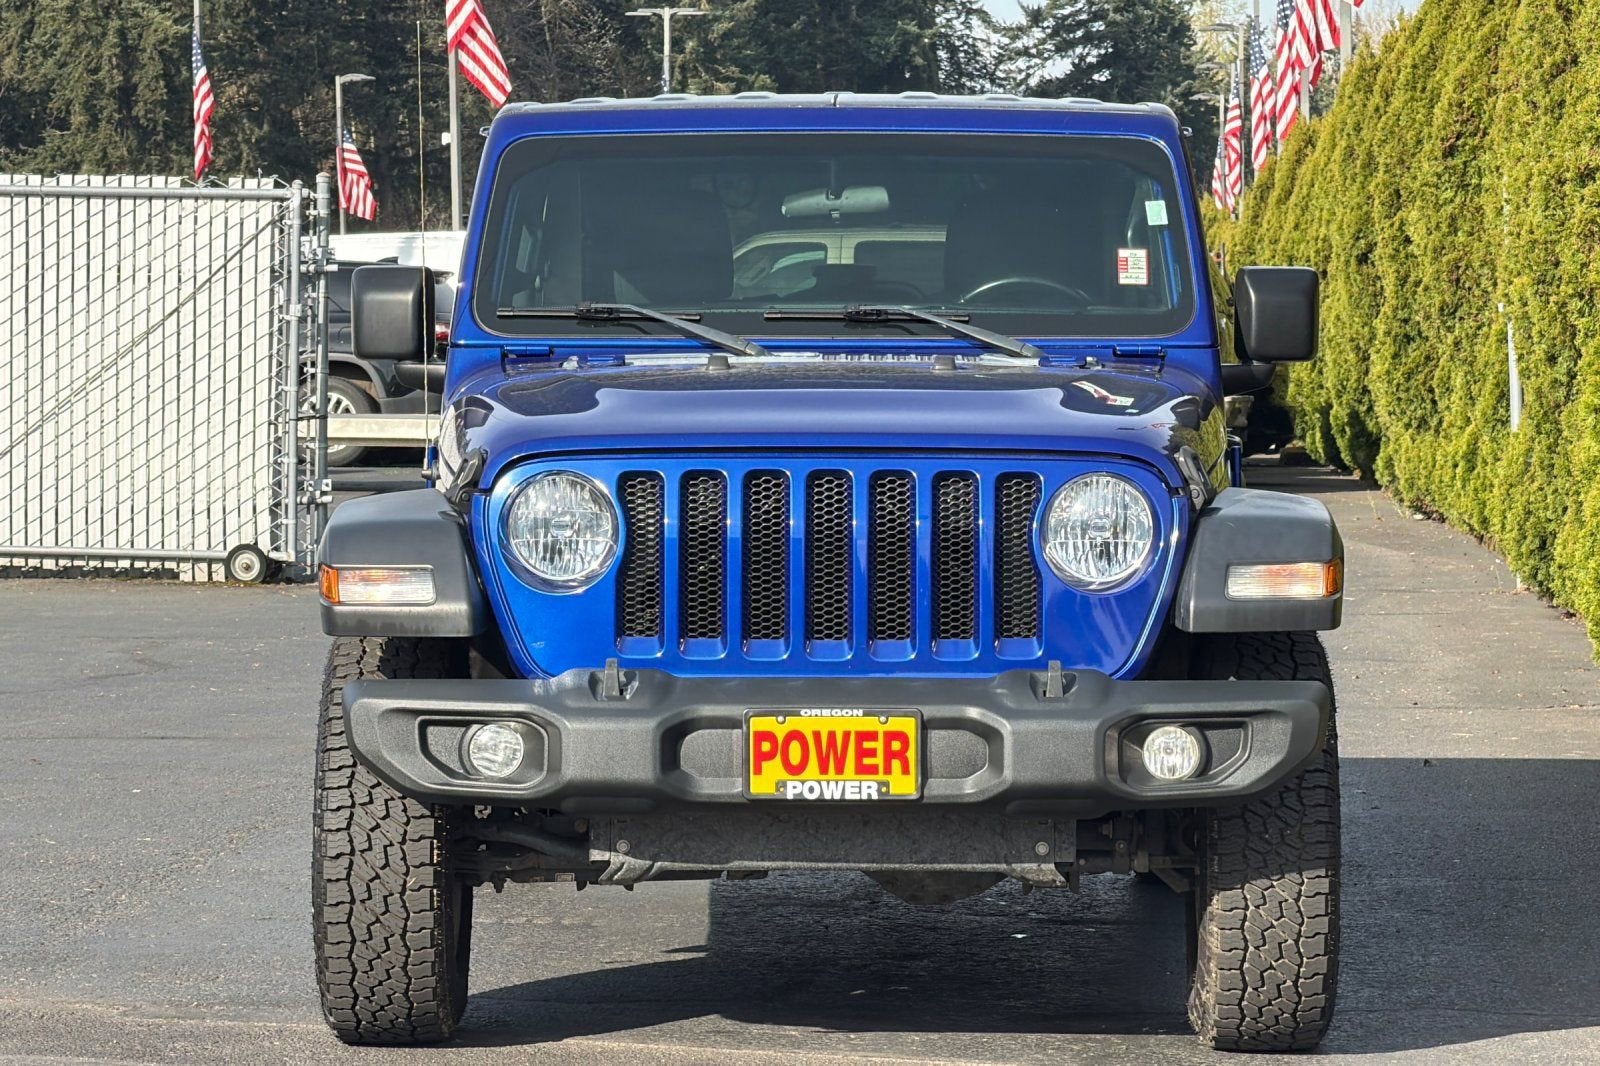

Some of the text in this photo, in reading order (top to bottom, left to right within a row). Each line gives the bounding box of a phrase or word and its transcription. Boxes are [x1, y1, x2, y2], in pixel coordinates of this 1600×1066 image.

[800, 709, 863, 717] OREGON
[752, 729, 911, 776] POWER
[786, 780, 878, 800] POWER
